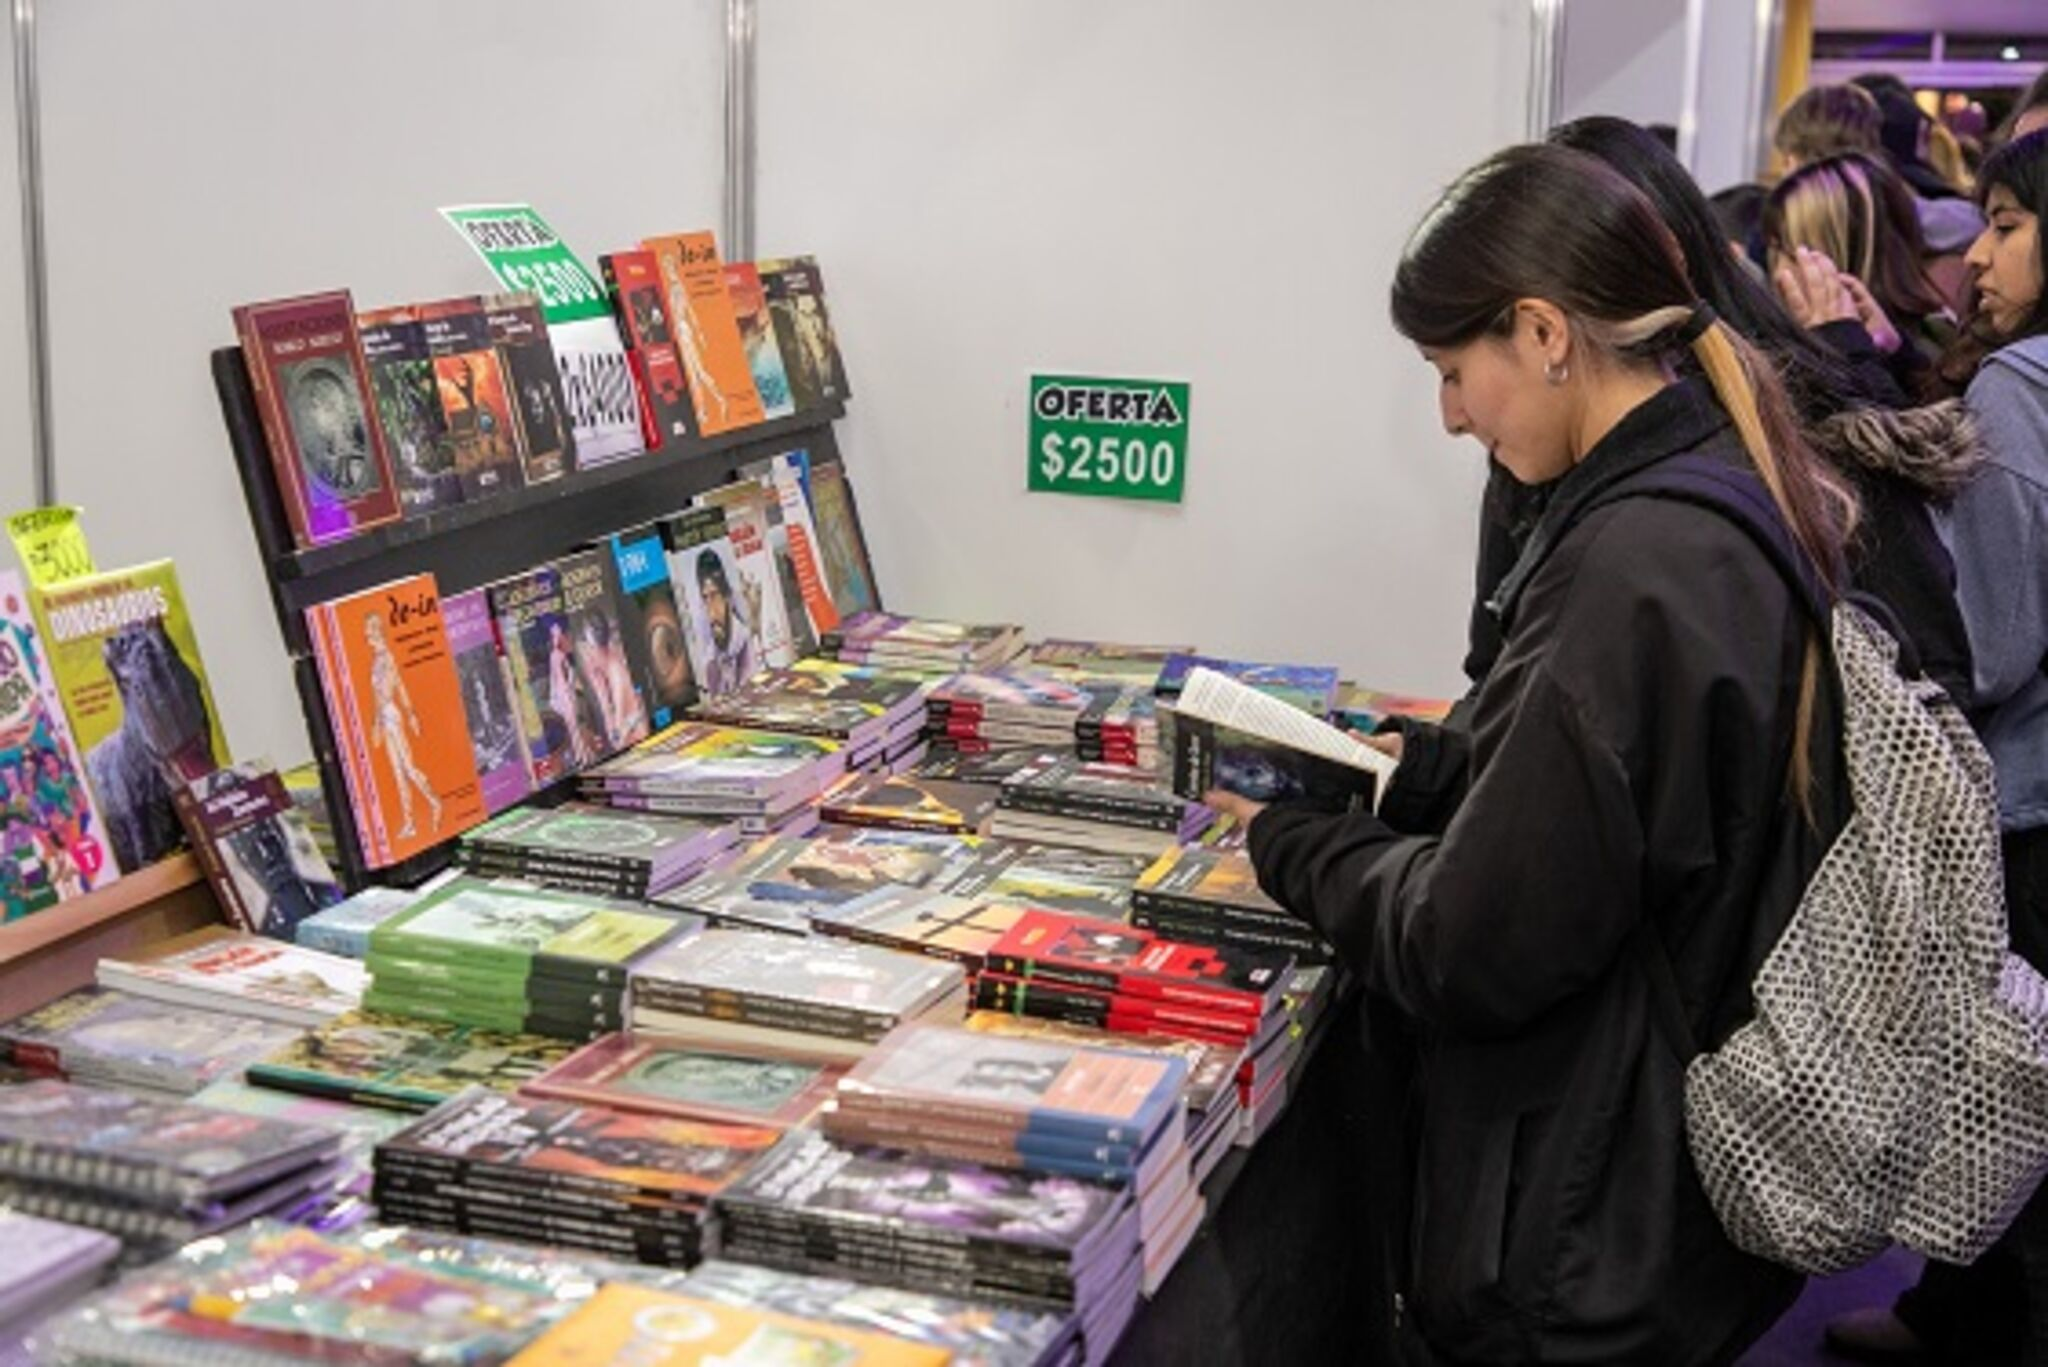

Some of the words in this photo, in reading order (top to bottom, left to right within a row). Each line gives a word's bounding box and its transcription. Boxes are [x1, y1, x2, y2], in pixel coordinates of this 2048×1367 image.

[464, 215, 558, 251] OFERTA
[501, 258, 599, 307] $2500
[1036, 386, 1181, 425] OFERTA
[1041, 431, 1174, 486] $2500
